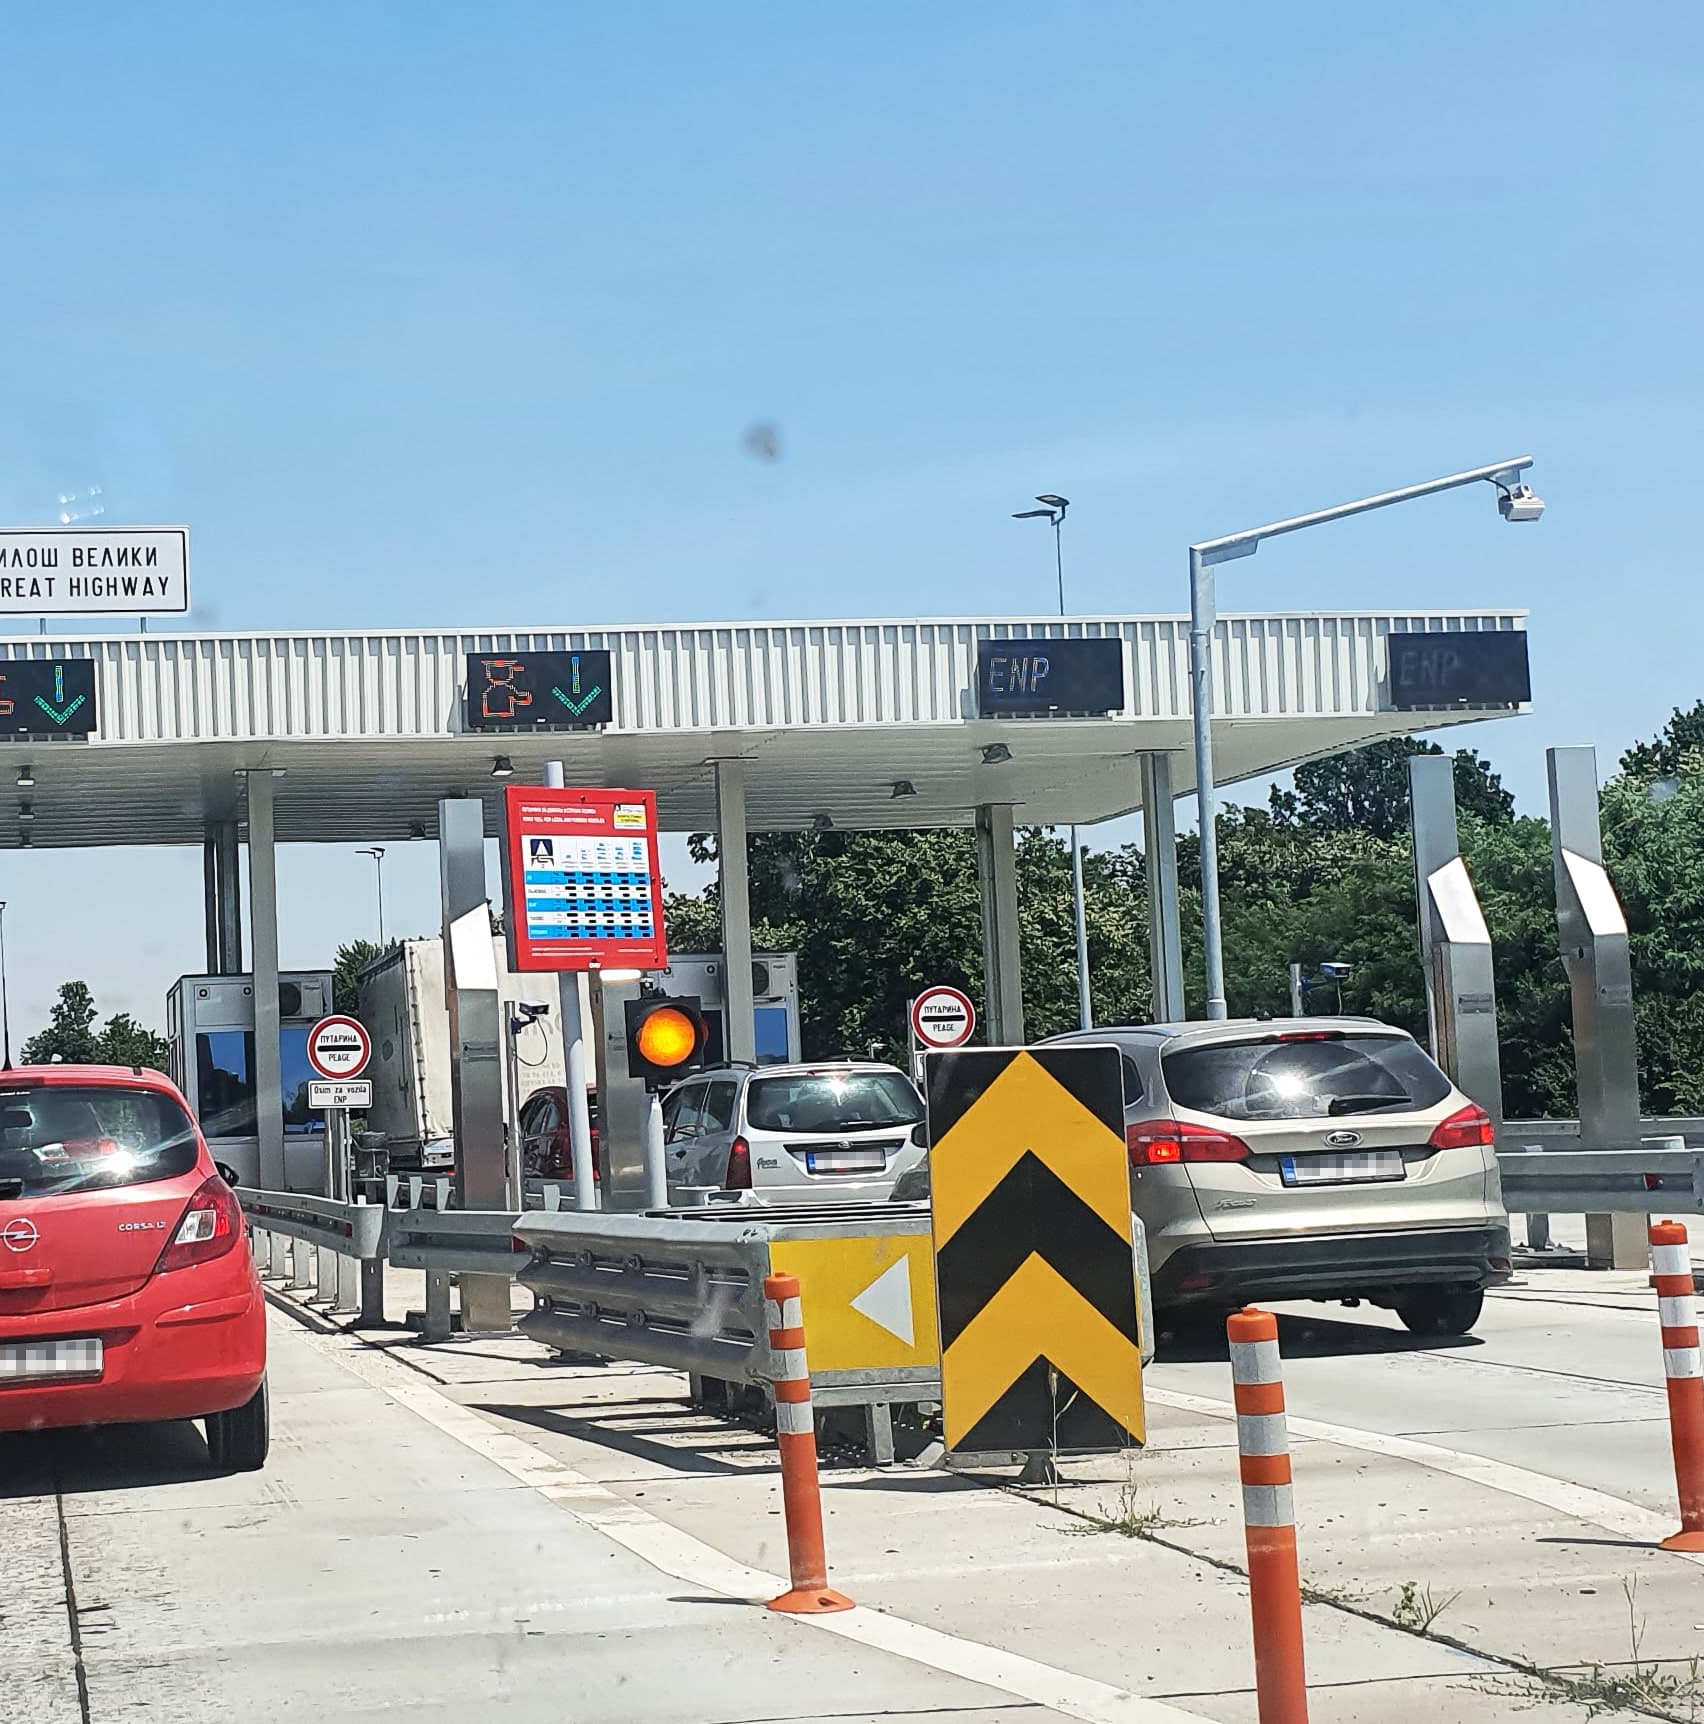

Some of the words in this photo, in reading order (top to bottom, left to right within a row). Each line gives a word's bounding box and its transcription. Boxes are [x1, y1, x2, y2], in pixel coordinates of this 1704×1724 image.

[72, 546, 158, 567] ВЕЛИКИ
[69, 576, 169, 597] HIGHWAY
[988, 656, 1050, 693] ENP
[923, 1005, 962, 1014] ПУТАРИНА
[320, 1034, 358, 1044] ПУТАРИНА
[328, 1053, 352, 1062] PEAGE
